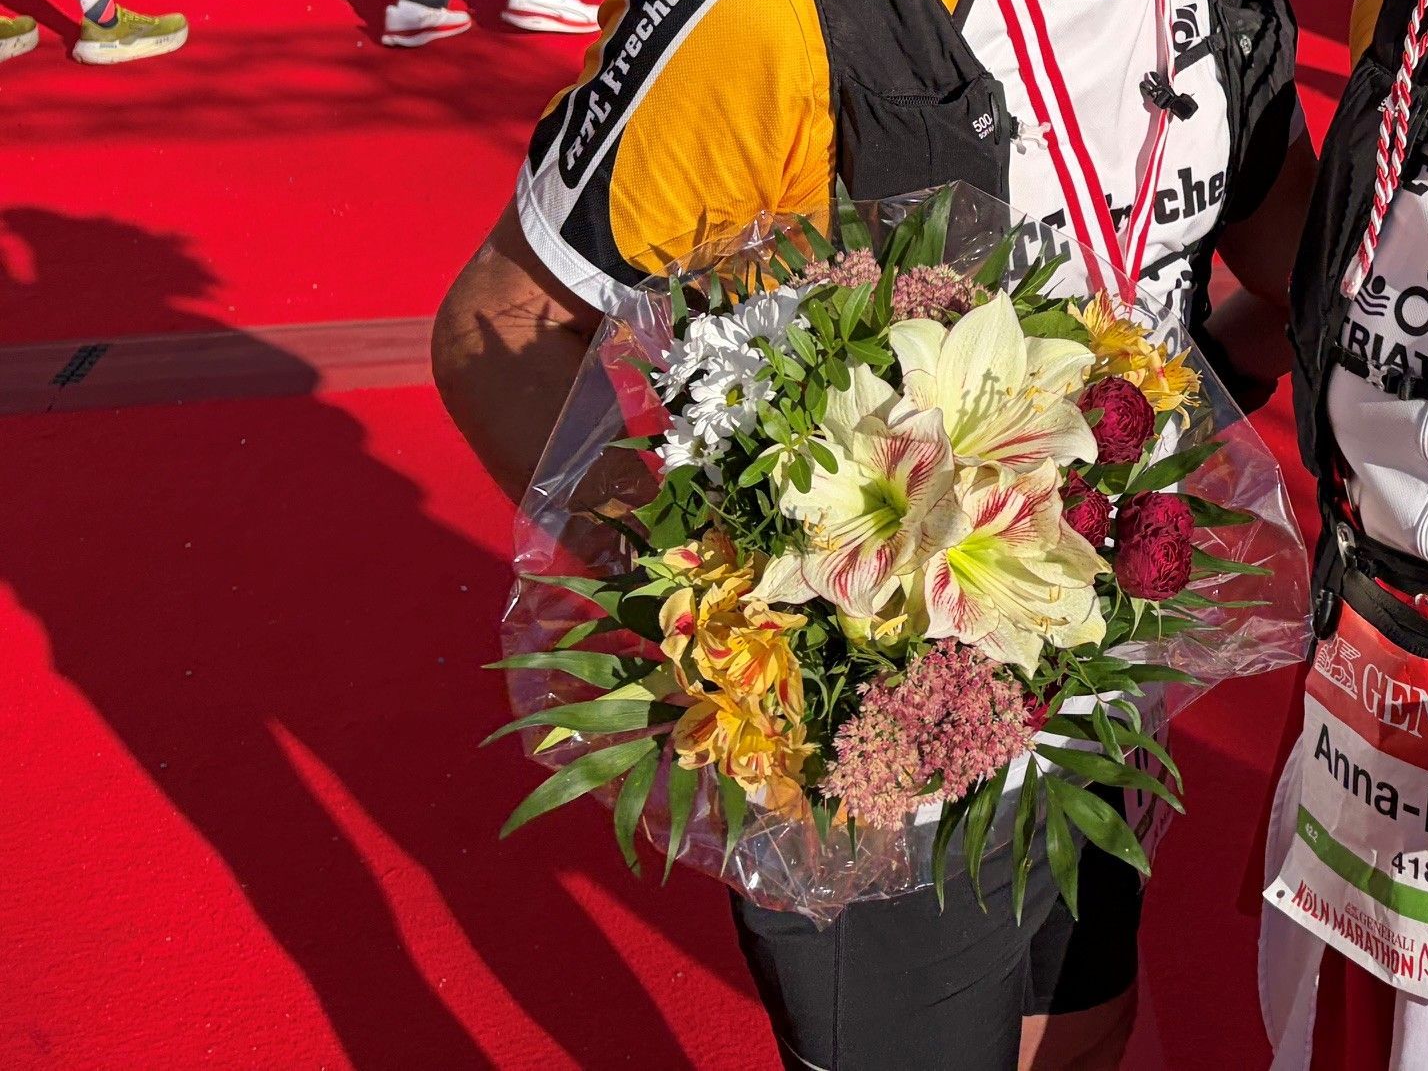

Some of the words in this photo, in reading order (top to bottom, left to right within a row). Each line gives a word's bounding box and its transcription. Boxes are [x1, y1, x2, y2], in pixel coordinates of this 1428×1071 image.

[972, 113, 993, 133] 500
[1291, 879, 1330, 926] KÖLN
[1332, 906, 1414, 980] MARATHON
[1359, 912, 1416, 953] GENERALI
